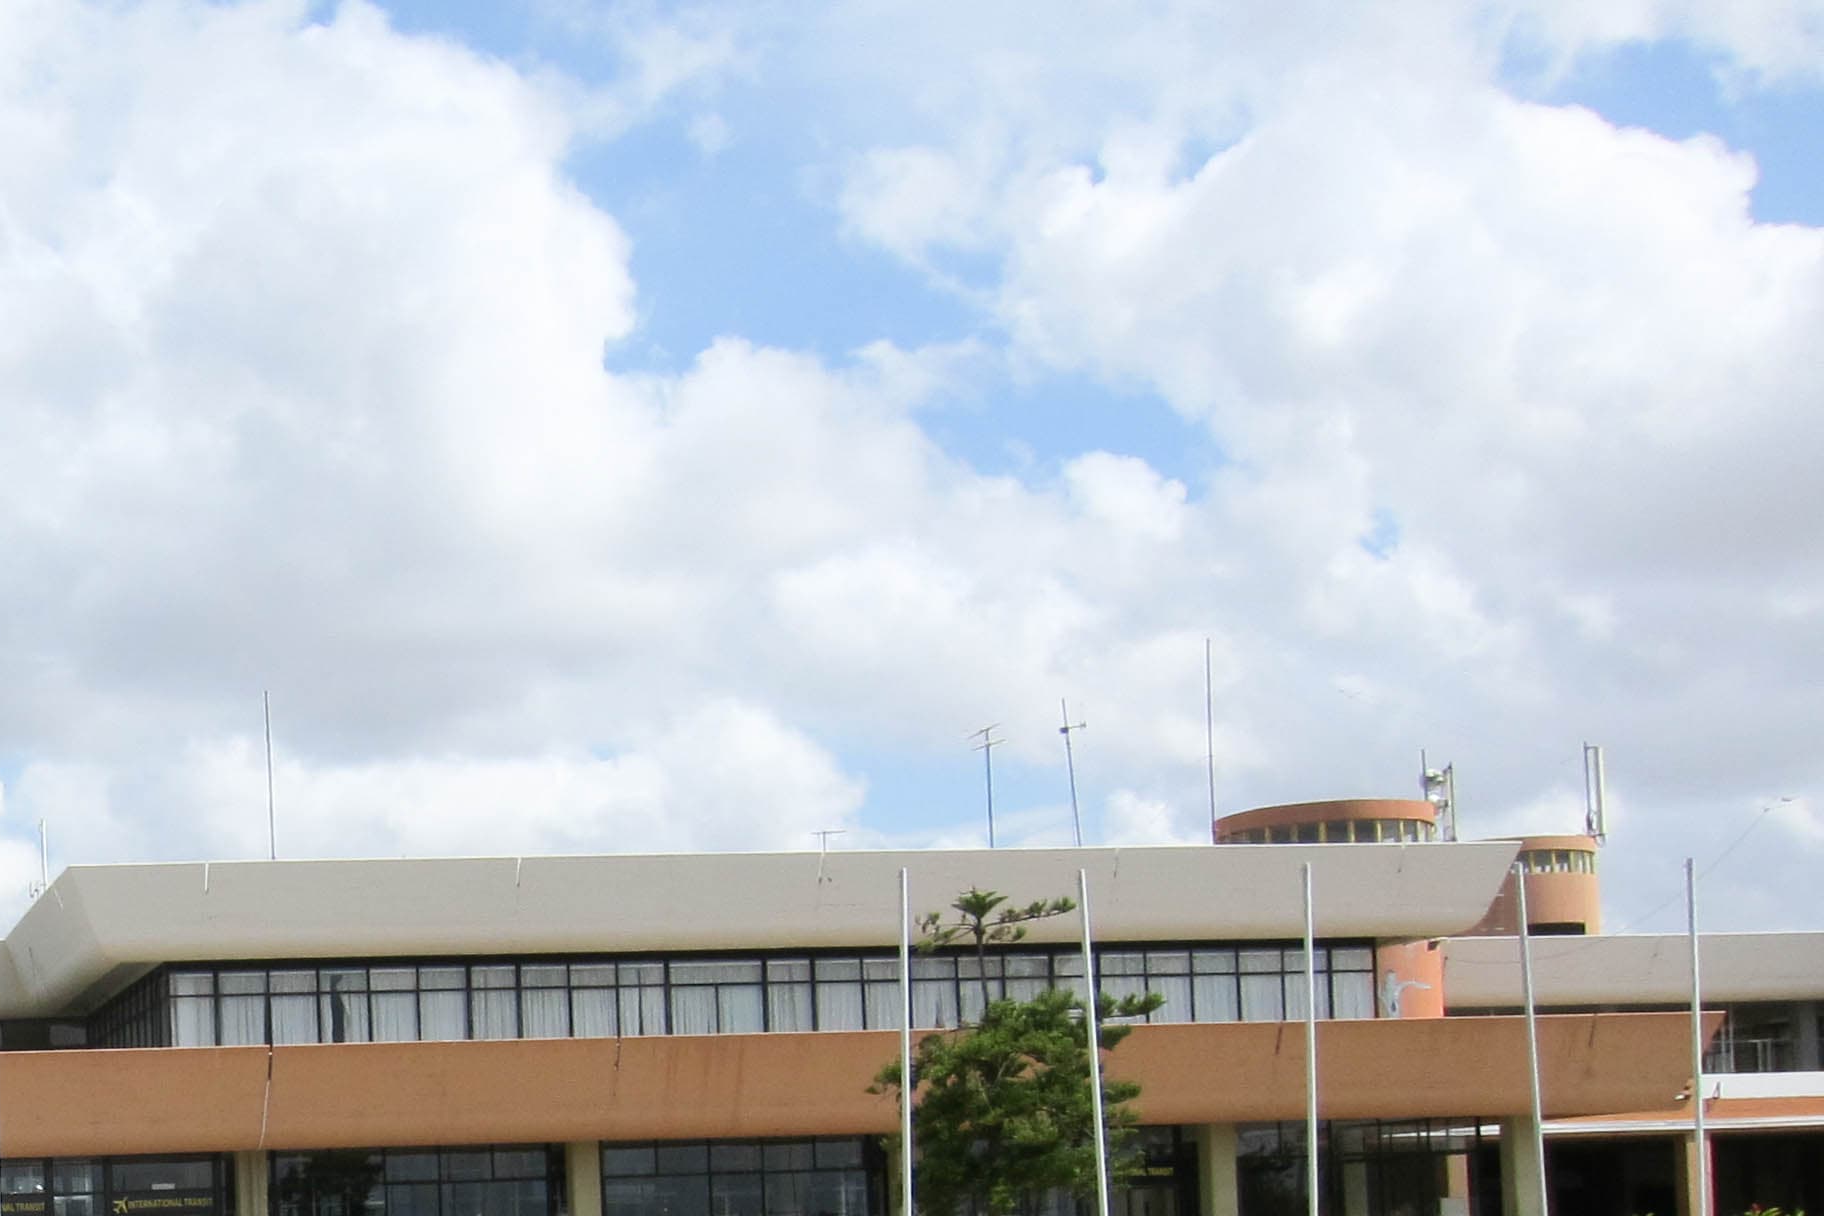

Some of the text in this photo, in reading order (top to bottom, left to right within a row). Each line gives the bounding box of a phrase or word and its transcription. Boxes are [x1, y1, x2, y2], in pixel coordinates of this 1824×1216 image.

[16, 1201, 45, 1212] TRANSIT
[128, 1197, 213, 1209] INTERNATIONAL TRANSIT
